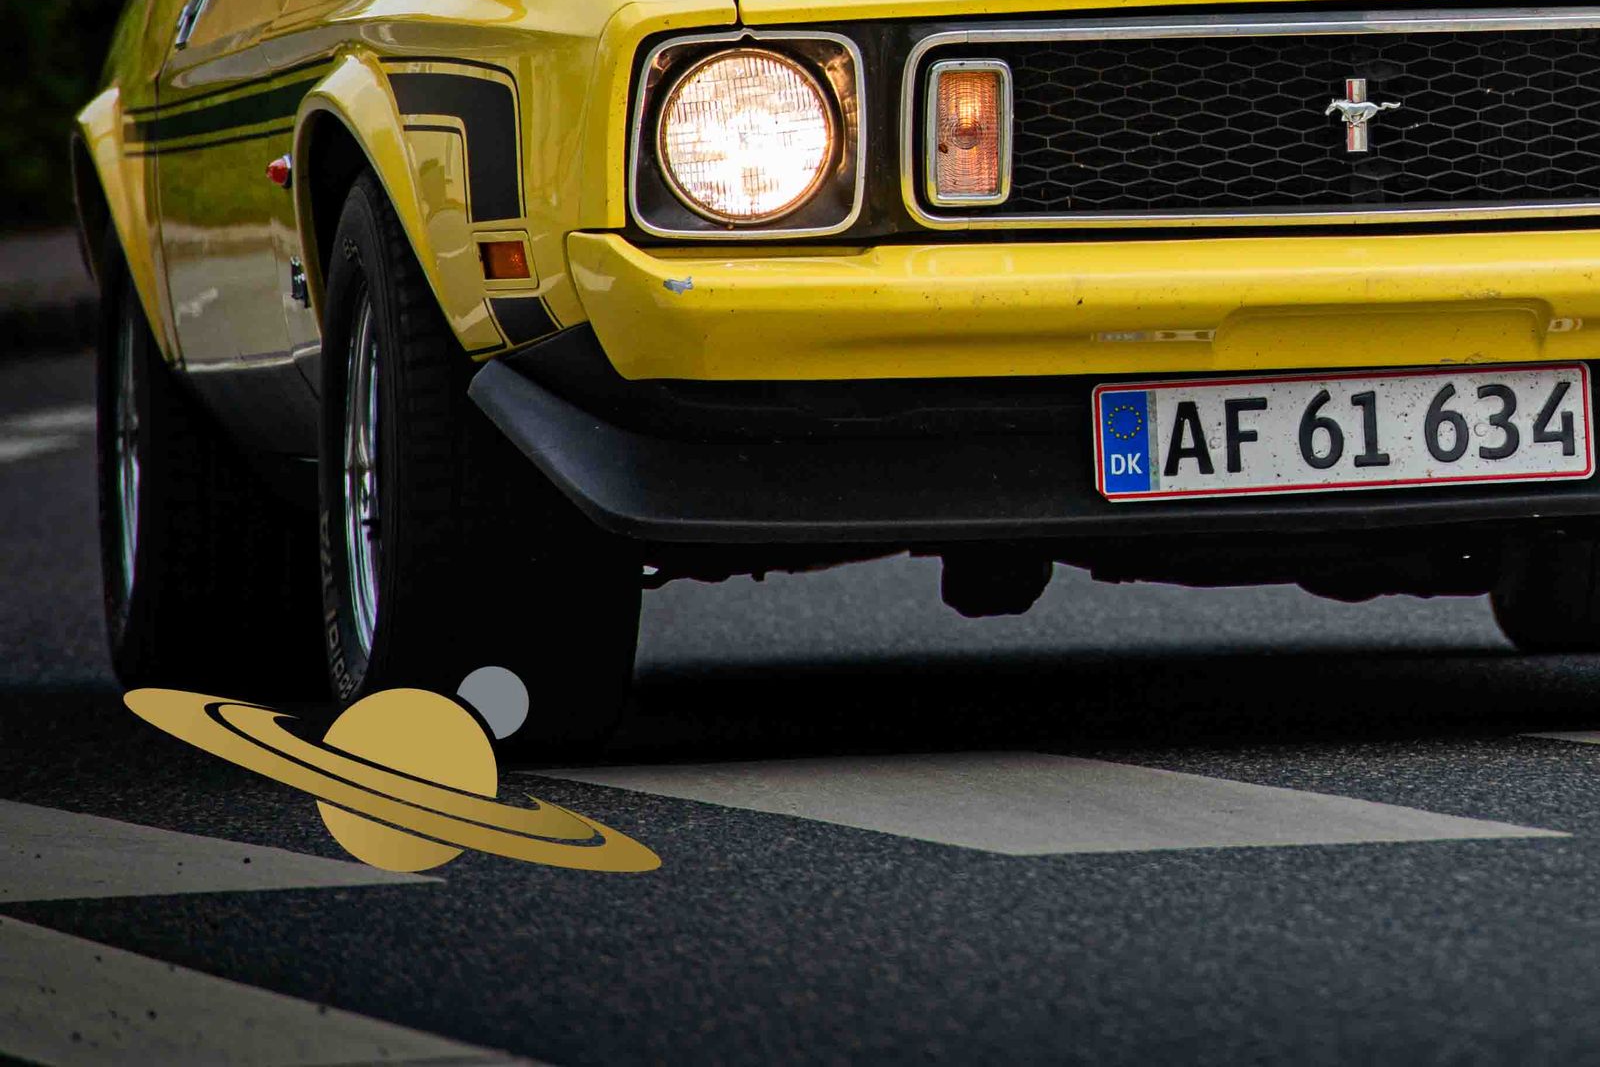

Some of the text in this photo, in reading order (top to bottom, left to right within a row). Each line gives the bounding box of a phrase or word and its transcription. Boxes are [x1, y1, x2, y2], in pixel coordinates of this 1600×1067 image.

[1163, 382, 1575, 476] AF 61 634
[1110, 452, 1142, 476] DK
